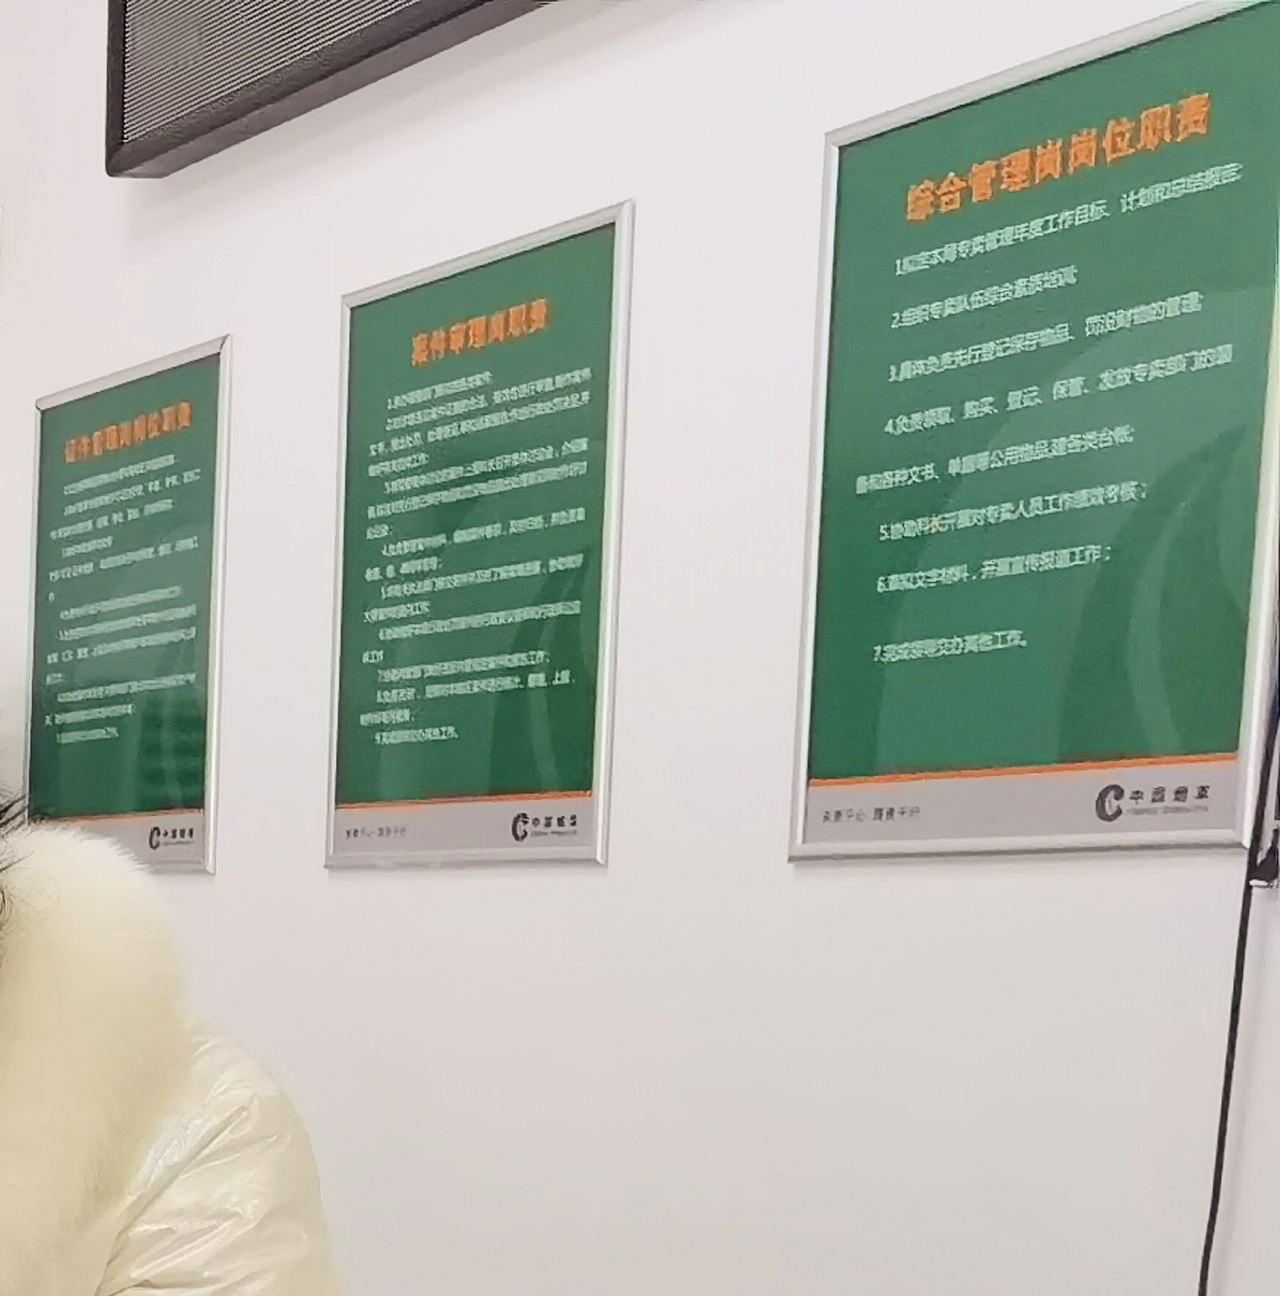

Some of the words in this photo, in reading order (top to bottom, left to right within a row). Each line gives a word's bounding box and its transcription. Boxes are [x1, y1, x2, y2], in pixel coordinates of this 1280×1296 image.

[906, 93, 1210, 220] 综合管理岗岗位职责
